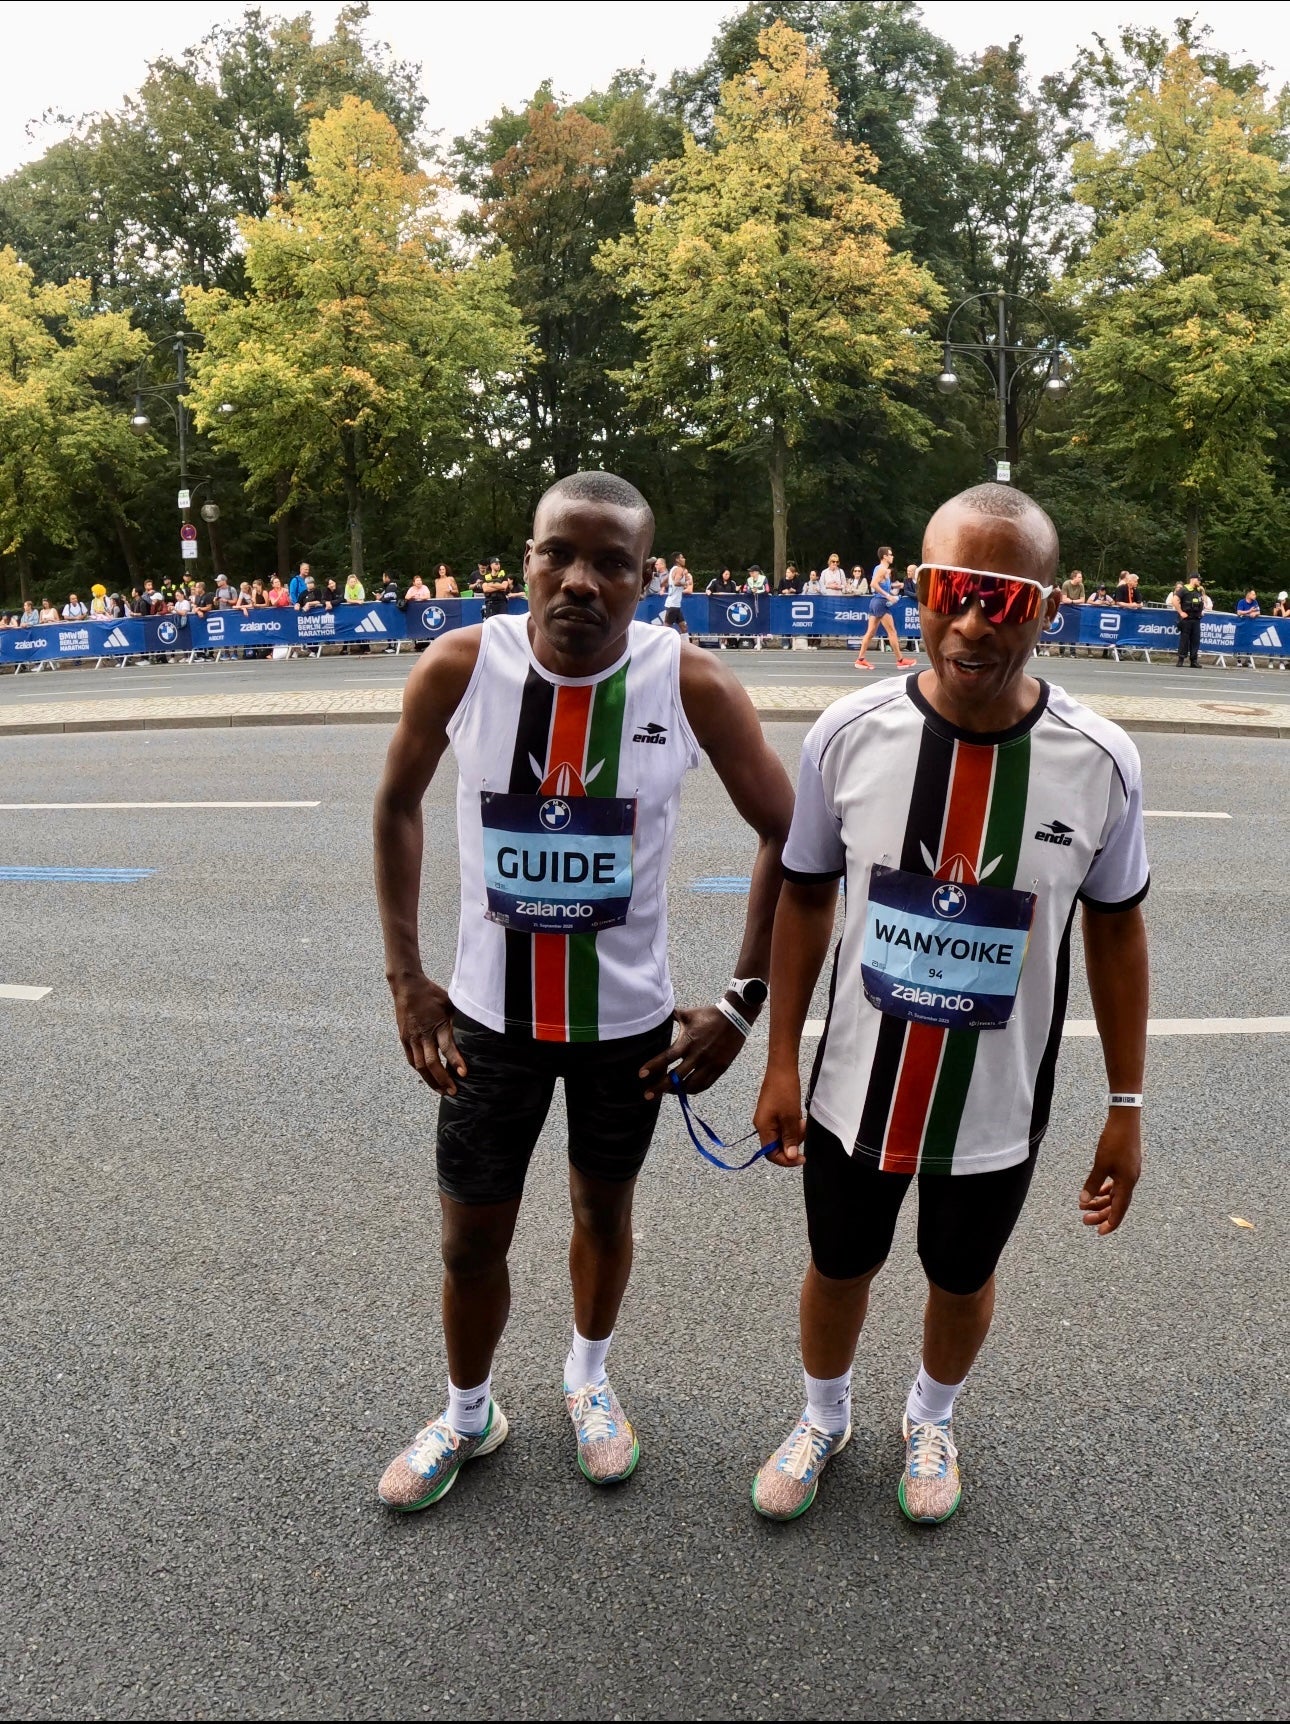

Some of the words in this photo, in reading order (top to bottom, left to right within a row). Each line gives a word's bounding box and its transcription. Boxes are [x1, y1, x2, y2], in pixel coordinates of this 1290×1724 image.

[905, 607, 919, 617] BM
[298, 615, 321, 624] BMW
[240, 621, 281, 632] zalando
[298, 623, 321, 631] BERLIN
[1200, 622, 1223, 633] BMW
[59, 632, 77, 640] BMW
[298, 629, 335, 637] MARATHON
[15, 638, 48, 649] zalando
[632, 733, 667, 745] enda
[1034, 830, 1073, 846] enda
[497, 846, 616, 884] GUIDE
[516, 900, 593, 918] zalando
[875, 918, 1014, 965] WANYOIKE
[928, 968, 944, 979] 94
[891, 983, 974, 1012] zalando
